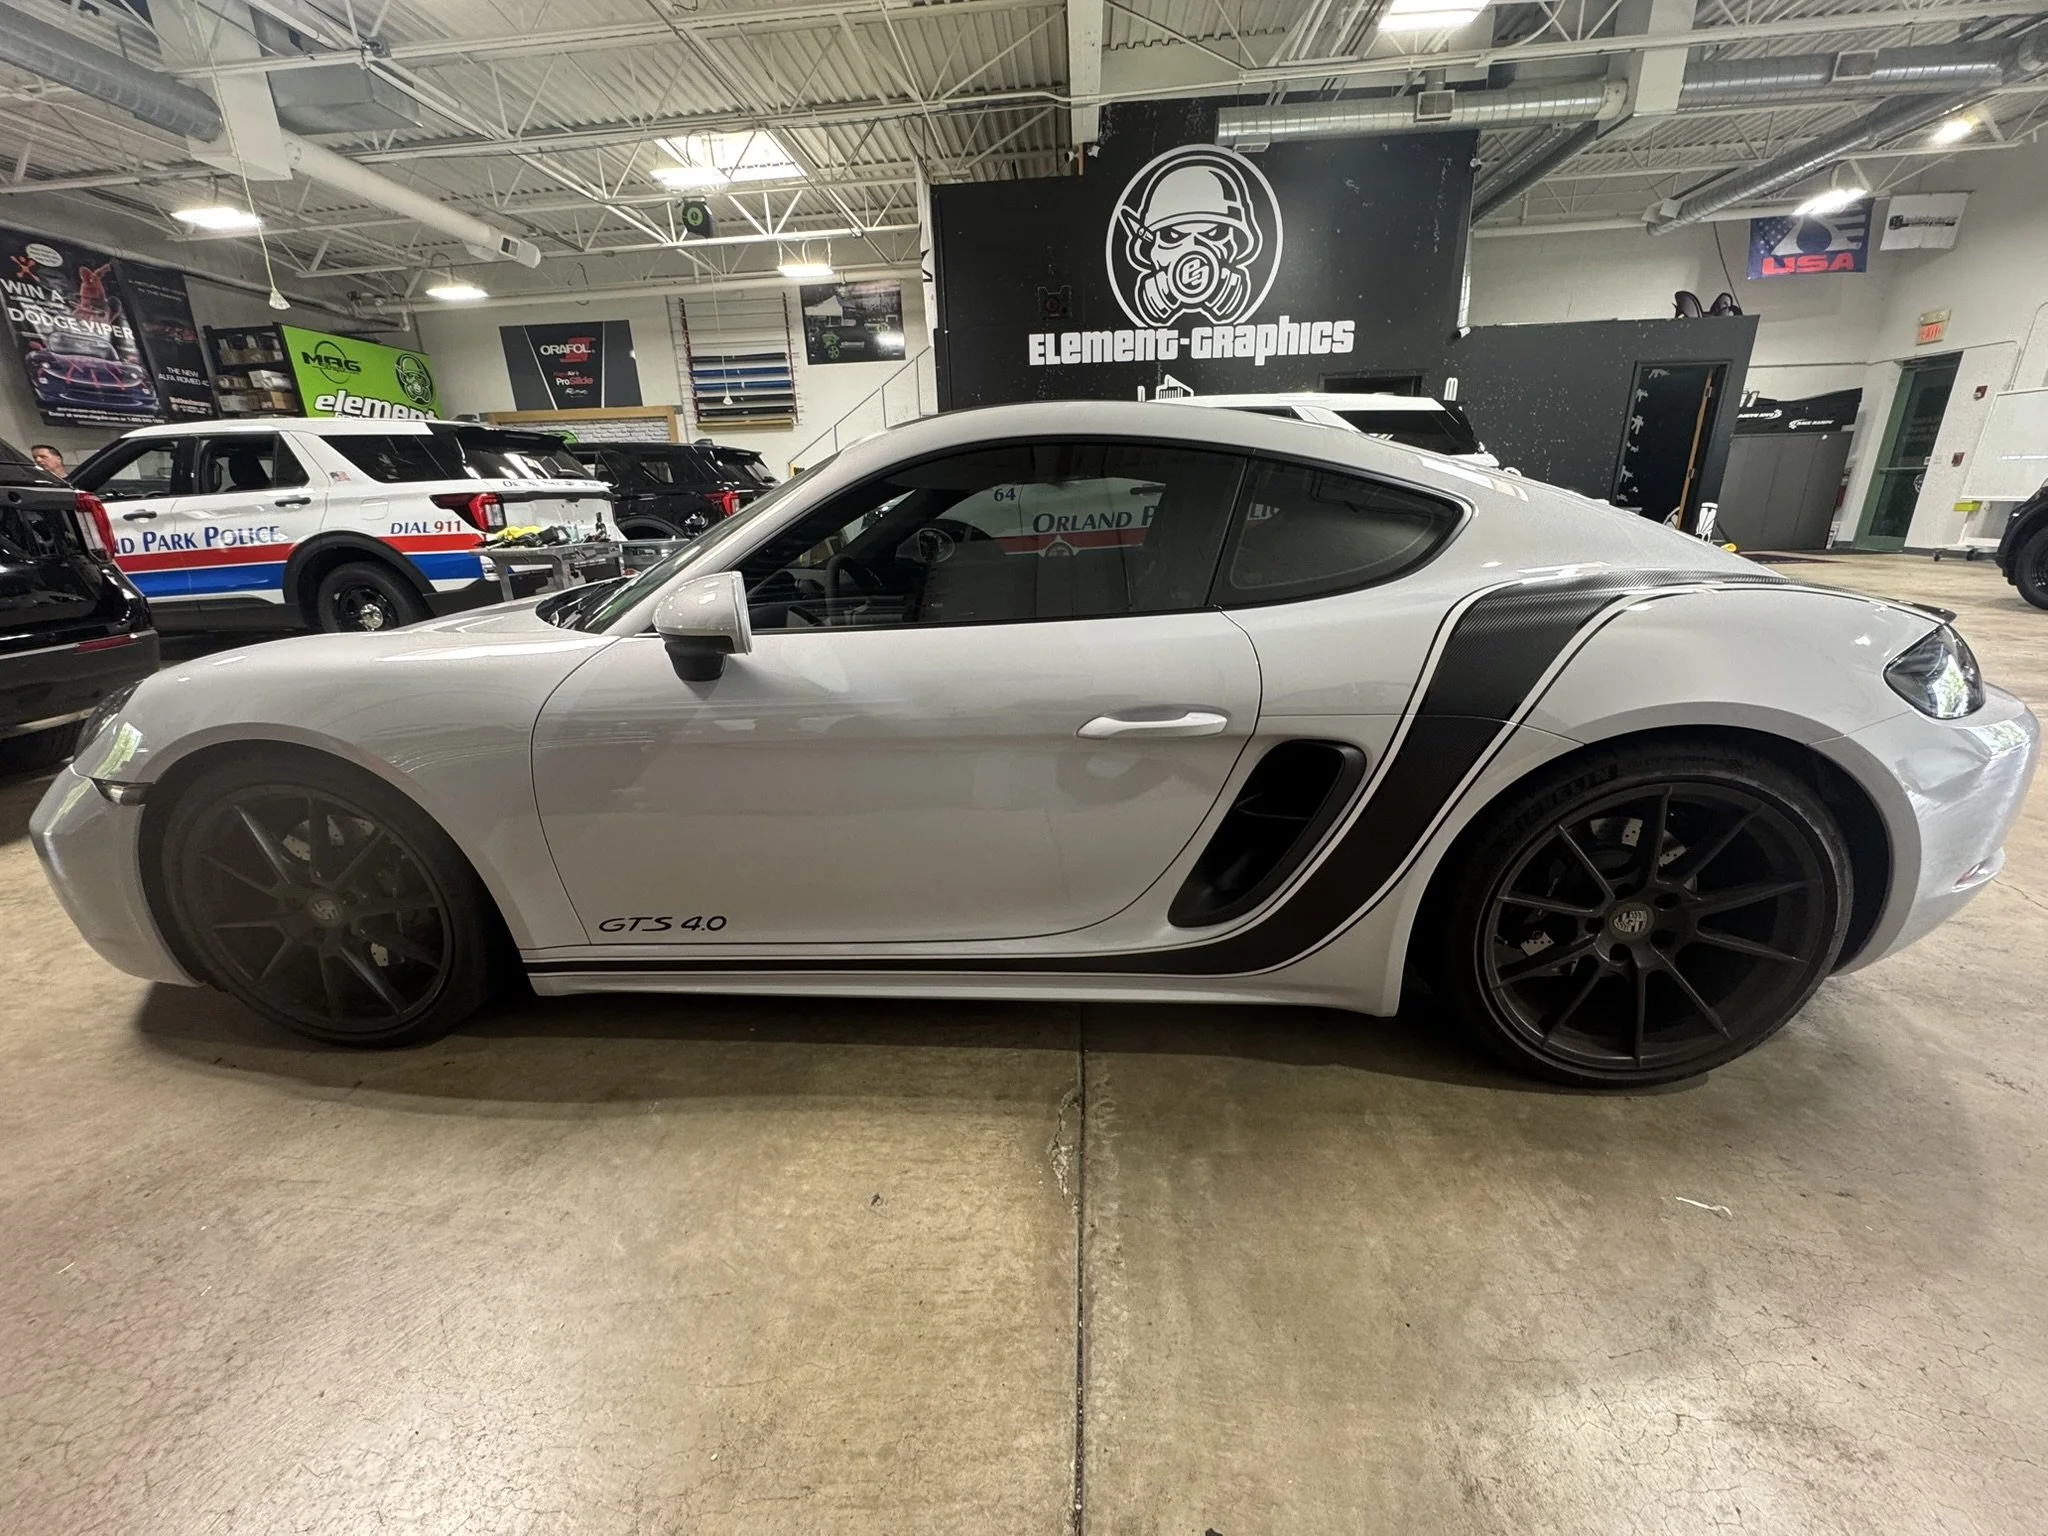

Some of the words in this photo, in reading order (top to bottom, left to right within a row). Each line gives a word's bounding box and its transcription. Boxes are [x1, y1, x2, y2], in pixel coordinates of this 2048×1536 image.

[1761, 252, 1855, 275] USA
[0, 278, 45, 299] WIN
[51, 290, 65, 303] A
[8, 307, 81, 332] DODGE
[81, 320, 135, 341] VIPER
[540, 343, 592, 356] ORAFOL
[158, 372, 176, 382] ALFA
[176, 375, 202, 386] ROMEO
[181, 368, 199, 378] NEW
[993, 486, 1017, 502] 64
[390, 521, 431, 535] DIAL
[433, 520, 462, 533] 911
[599, 916, 674, 932] GTS
[680, 915, 728, 932] 4.0
